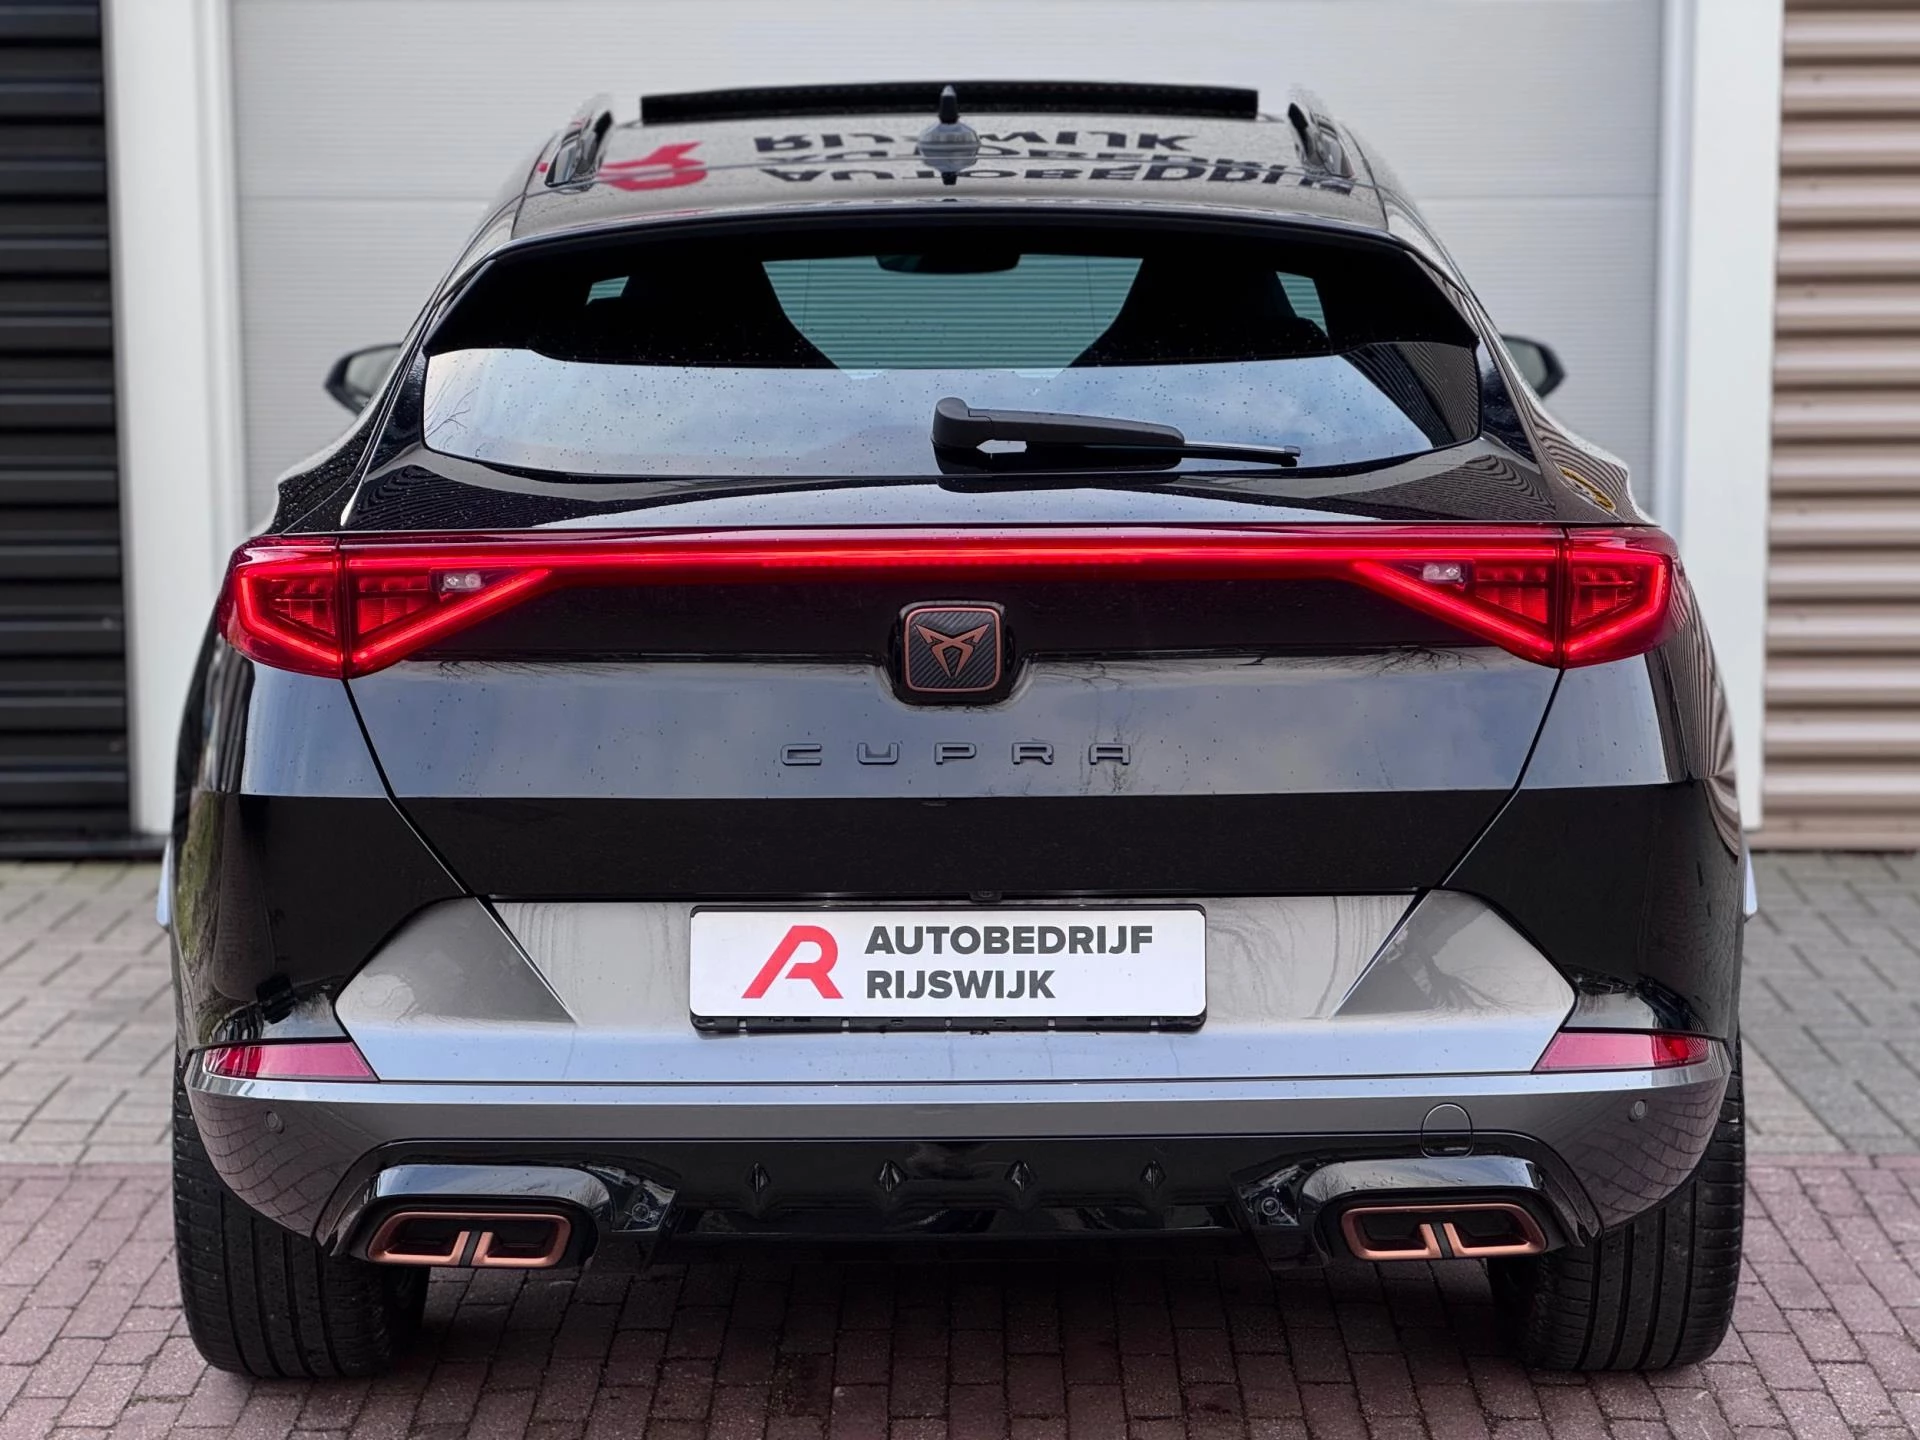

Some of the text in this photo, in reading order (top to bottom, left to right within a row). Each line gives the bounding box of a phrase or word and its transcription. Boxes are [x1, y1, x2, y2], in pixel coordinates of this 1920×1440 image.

[780, 742, 1131, 766] CUPRA
[864, 925, 1153, 955] AUTOBEDRIJF
[866, 970, 1056, 999] RIJSWIJK
